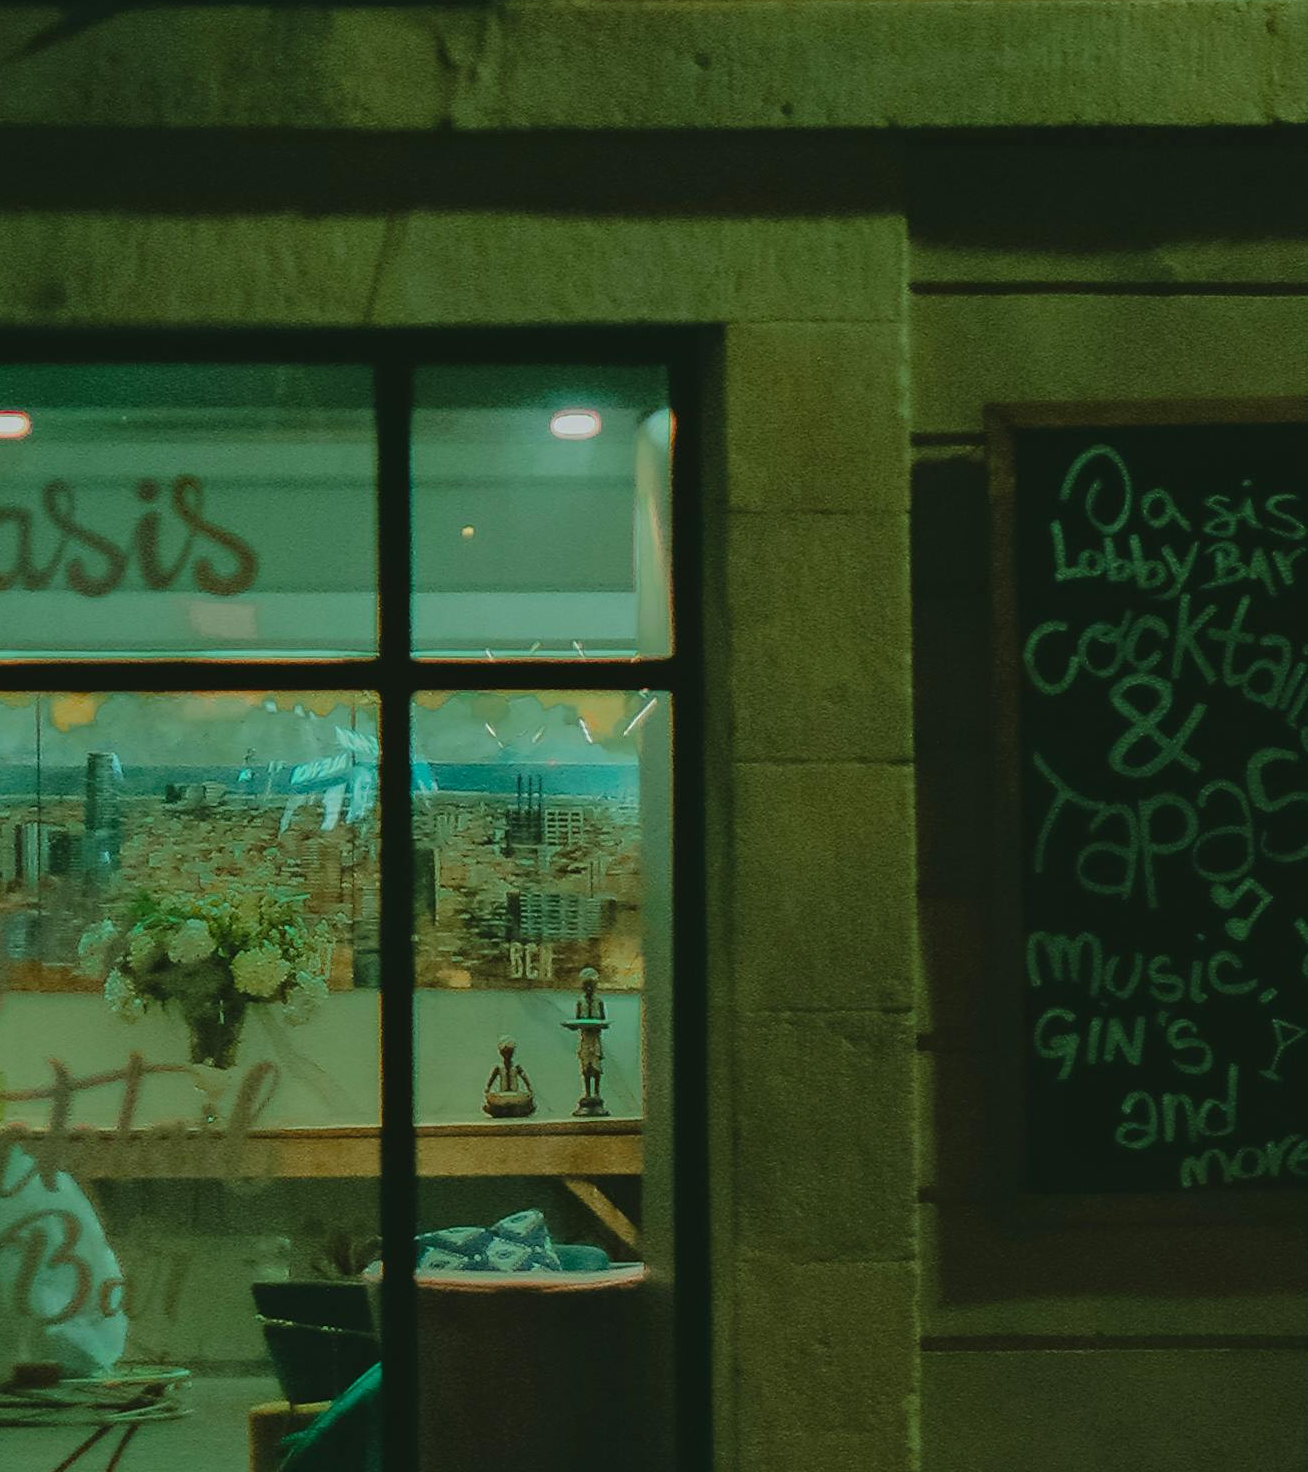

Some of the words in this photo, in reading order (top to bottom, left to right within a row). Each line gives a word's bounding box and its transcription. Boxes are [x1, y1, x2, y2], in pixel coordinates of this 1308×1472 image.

[1059, 444, 1308, 541] Oasis
[1050, 519, 1200, 601] Lobby
[1109, 671, 1208, 778] &
[1114, 1062, 1239, 1149] and
